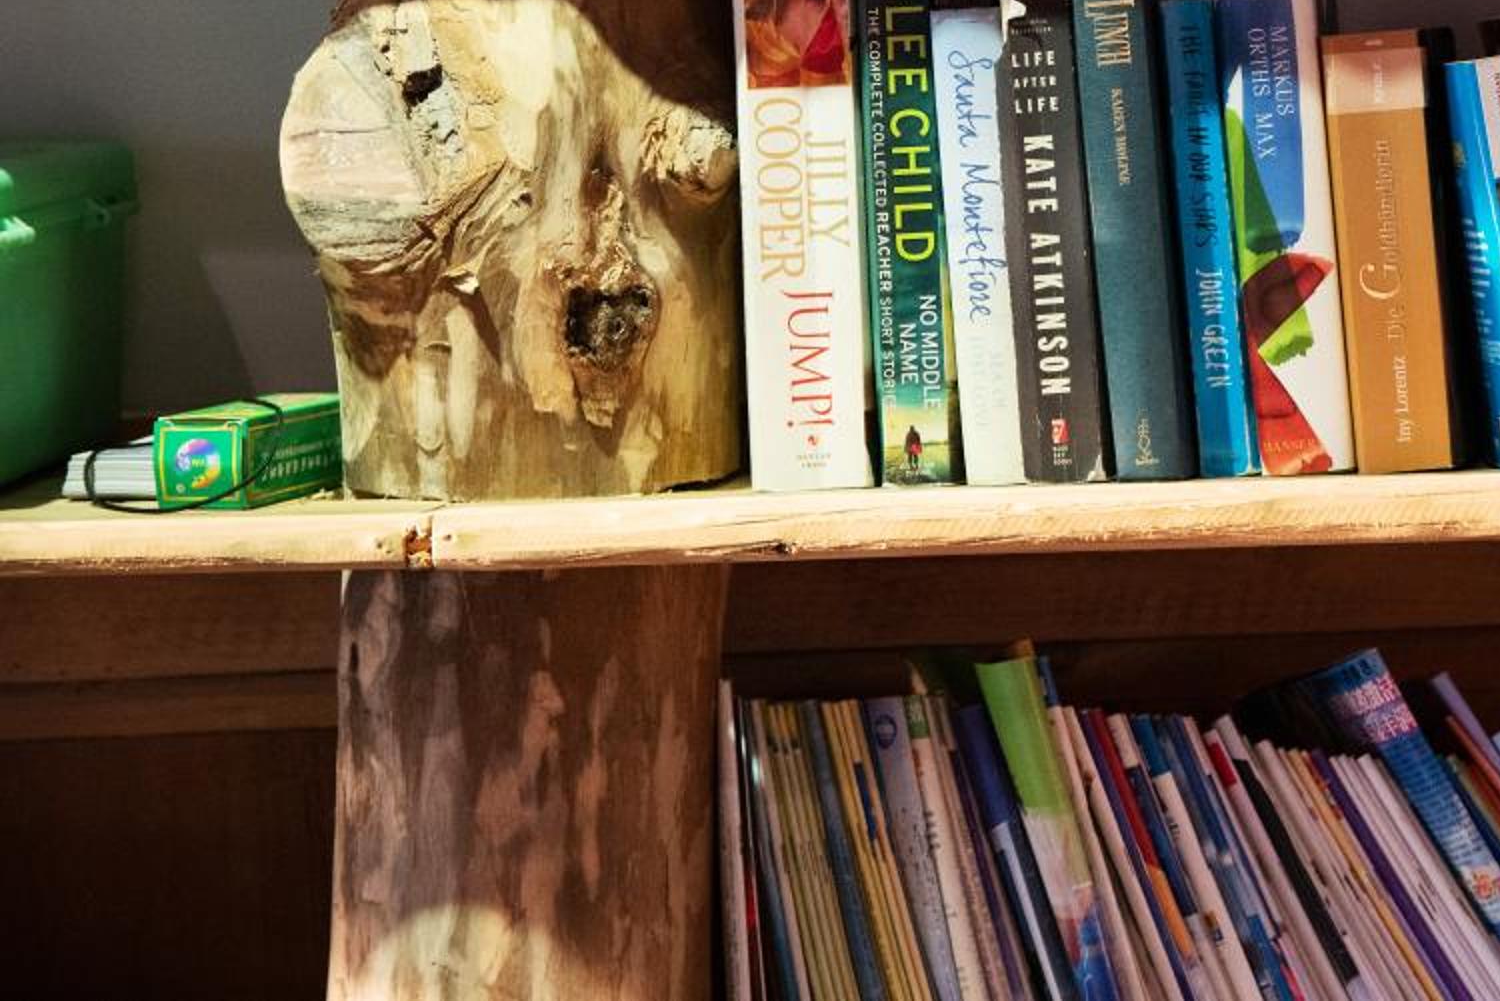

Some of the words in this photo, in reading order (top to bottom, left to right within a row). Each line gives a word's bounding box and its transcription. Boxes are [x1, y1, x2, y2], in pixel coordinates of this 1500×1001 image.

[867, 7, 882, 36] THE
[885, 5, 930, 95] LEE
[869, 40, 886, 118] COMPLETE
[1011, 50, 1056, 69] LIFE
[1013, 76, 1058, 90] AFTER
[1247, 28, 1266, 97] ORTHS
[1271, 26, 1295, 116] MARKUS
[947, 49, 994, 149] Santa
[1014, 96, 1060, 115] LIFE
[871, 121, 889, 207] COLLECTED
[1187, 126, 1212, 146] IN
[1189, 151, 1213, 182] OUR
[1256, 109, 1278, 160] MAX
[752, 97, 807, 284] COOPER
[804, 132, 851, 248] JILLY
[889, 111, 935, 262] CHILD
[1022, 134, 1055, 215] KATE
[875, 211, 893, 292] REACHER
[959, 159, 1008, 325] Montefiore
[1191, 192, 1219, 247] STARS
[879, 297, 894, 345] SHORT
[919, 295, 939, 324] NO
[1029, 230, 1071, 397] ATKINSON
[1195, 267, 1225, 316] JOHN
[782, 289, 835, 430] JUMP!
[899, 323, 919, 384] NAME
[920, 330, 942, 409] MIDDLE
[1203, 325, 1233, 388] GREEN
[1393, 355, 1410, 411] Lorentz
